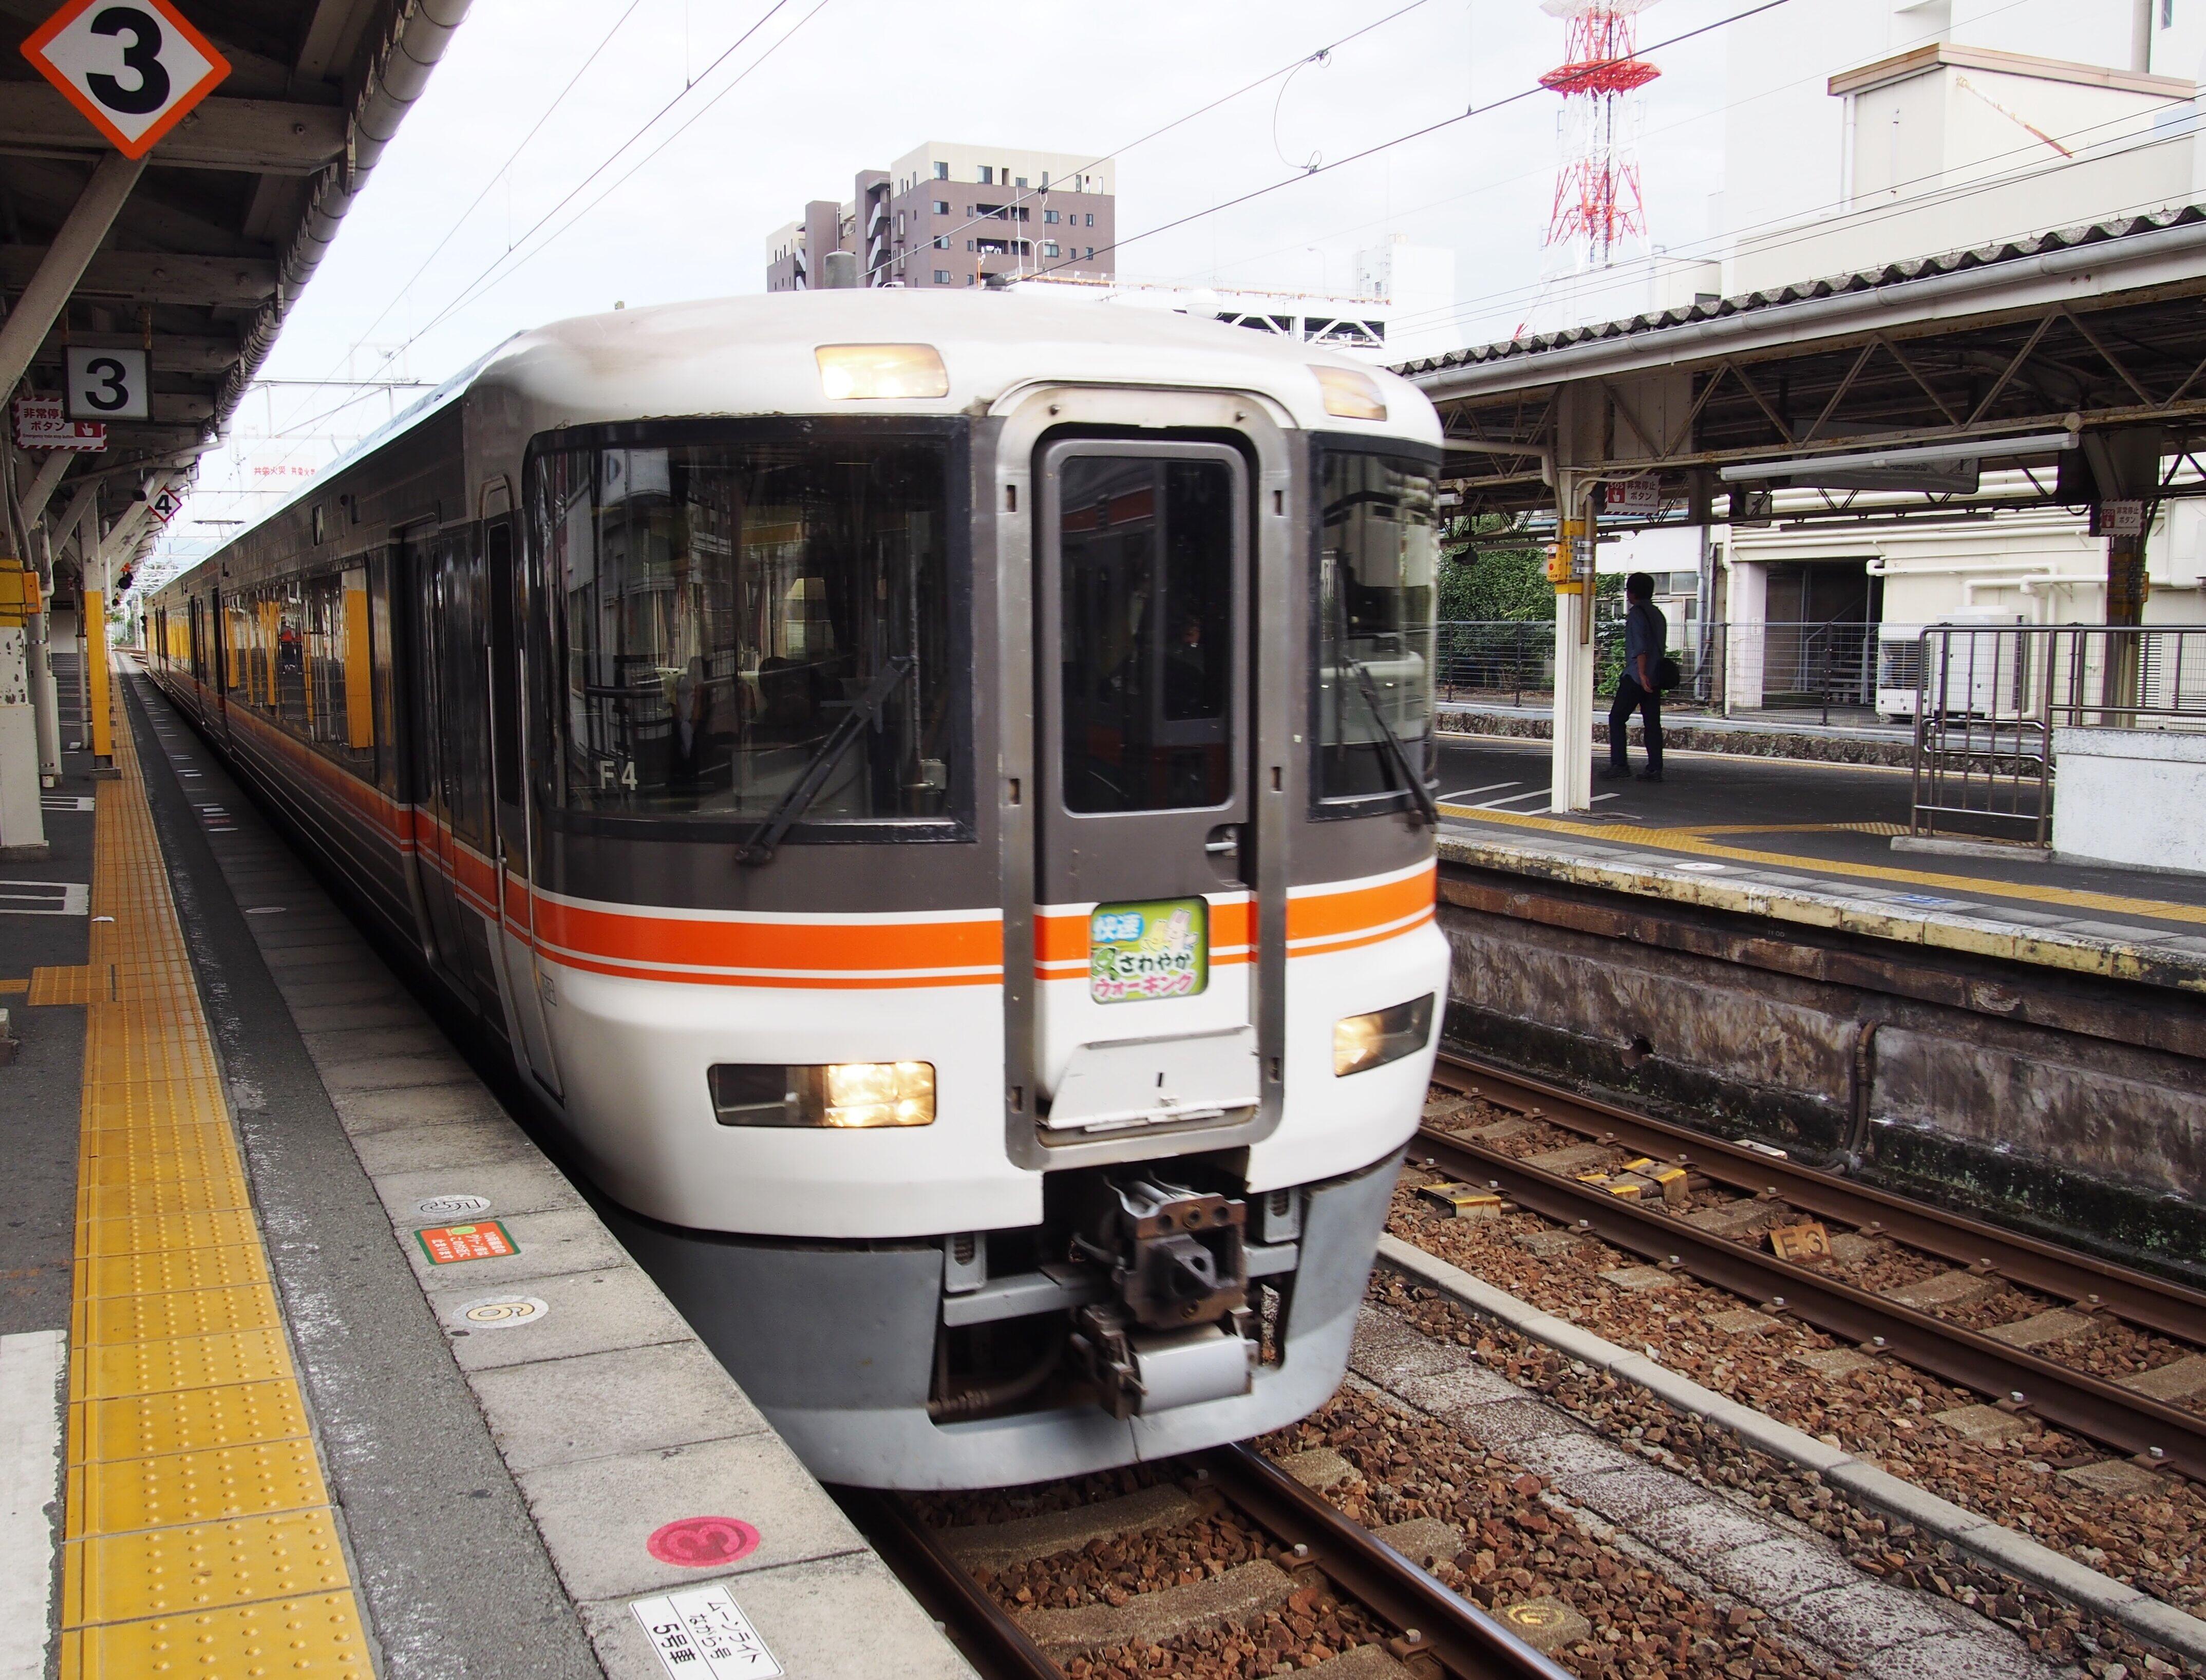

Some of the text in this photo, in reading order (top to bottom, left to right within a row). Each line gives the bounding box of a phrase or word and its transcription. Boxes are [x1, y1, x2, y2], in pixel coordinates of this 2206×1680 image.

[86, 7, 170, 114] 3
[85, 357, 129, 410] 3
[31, 421, 65, 431] ボタン
[1627, 481, 1656, 490] 非常停止
[1630, 492, 1652, 500] ボタン
[155, 495, 172, 514] 4
[1120, 953, 1191, 973] さわやか
[1780, 1230, 1823, 1258] E3
[653, 1623, 696, 1665] 5号車
[689, 1613, 732, 1659] ながら号
[707, 1601, 762, 1664] ムーンライト
